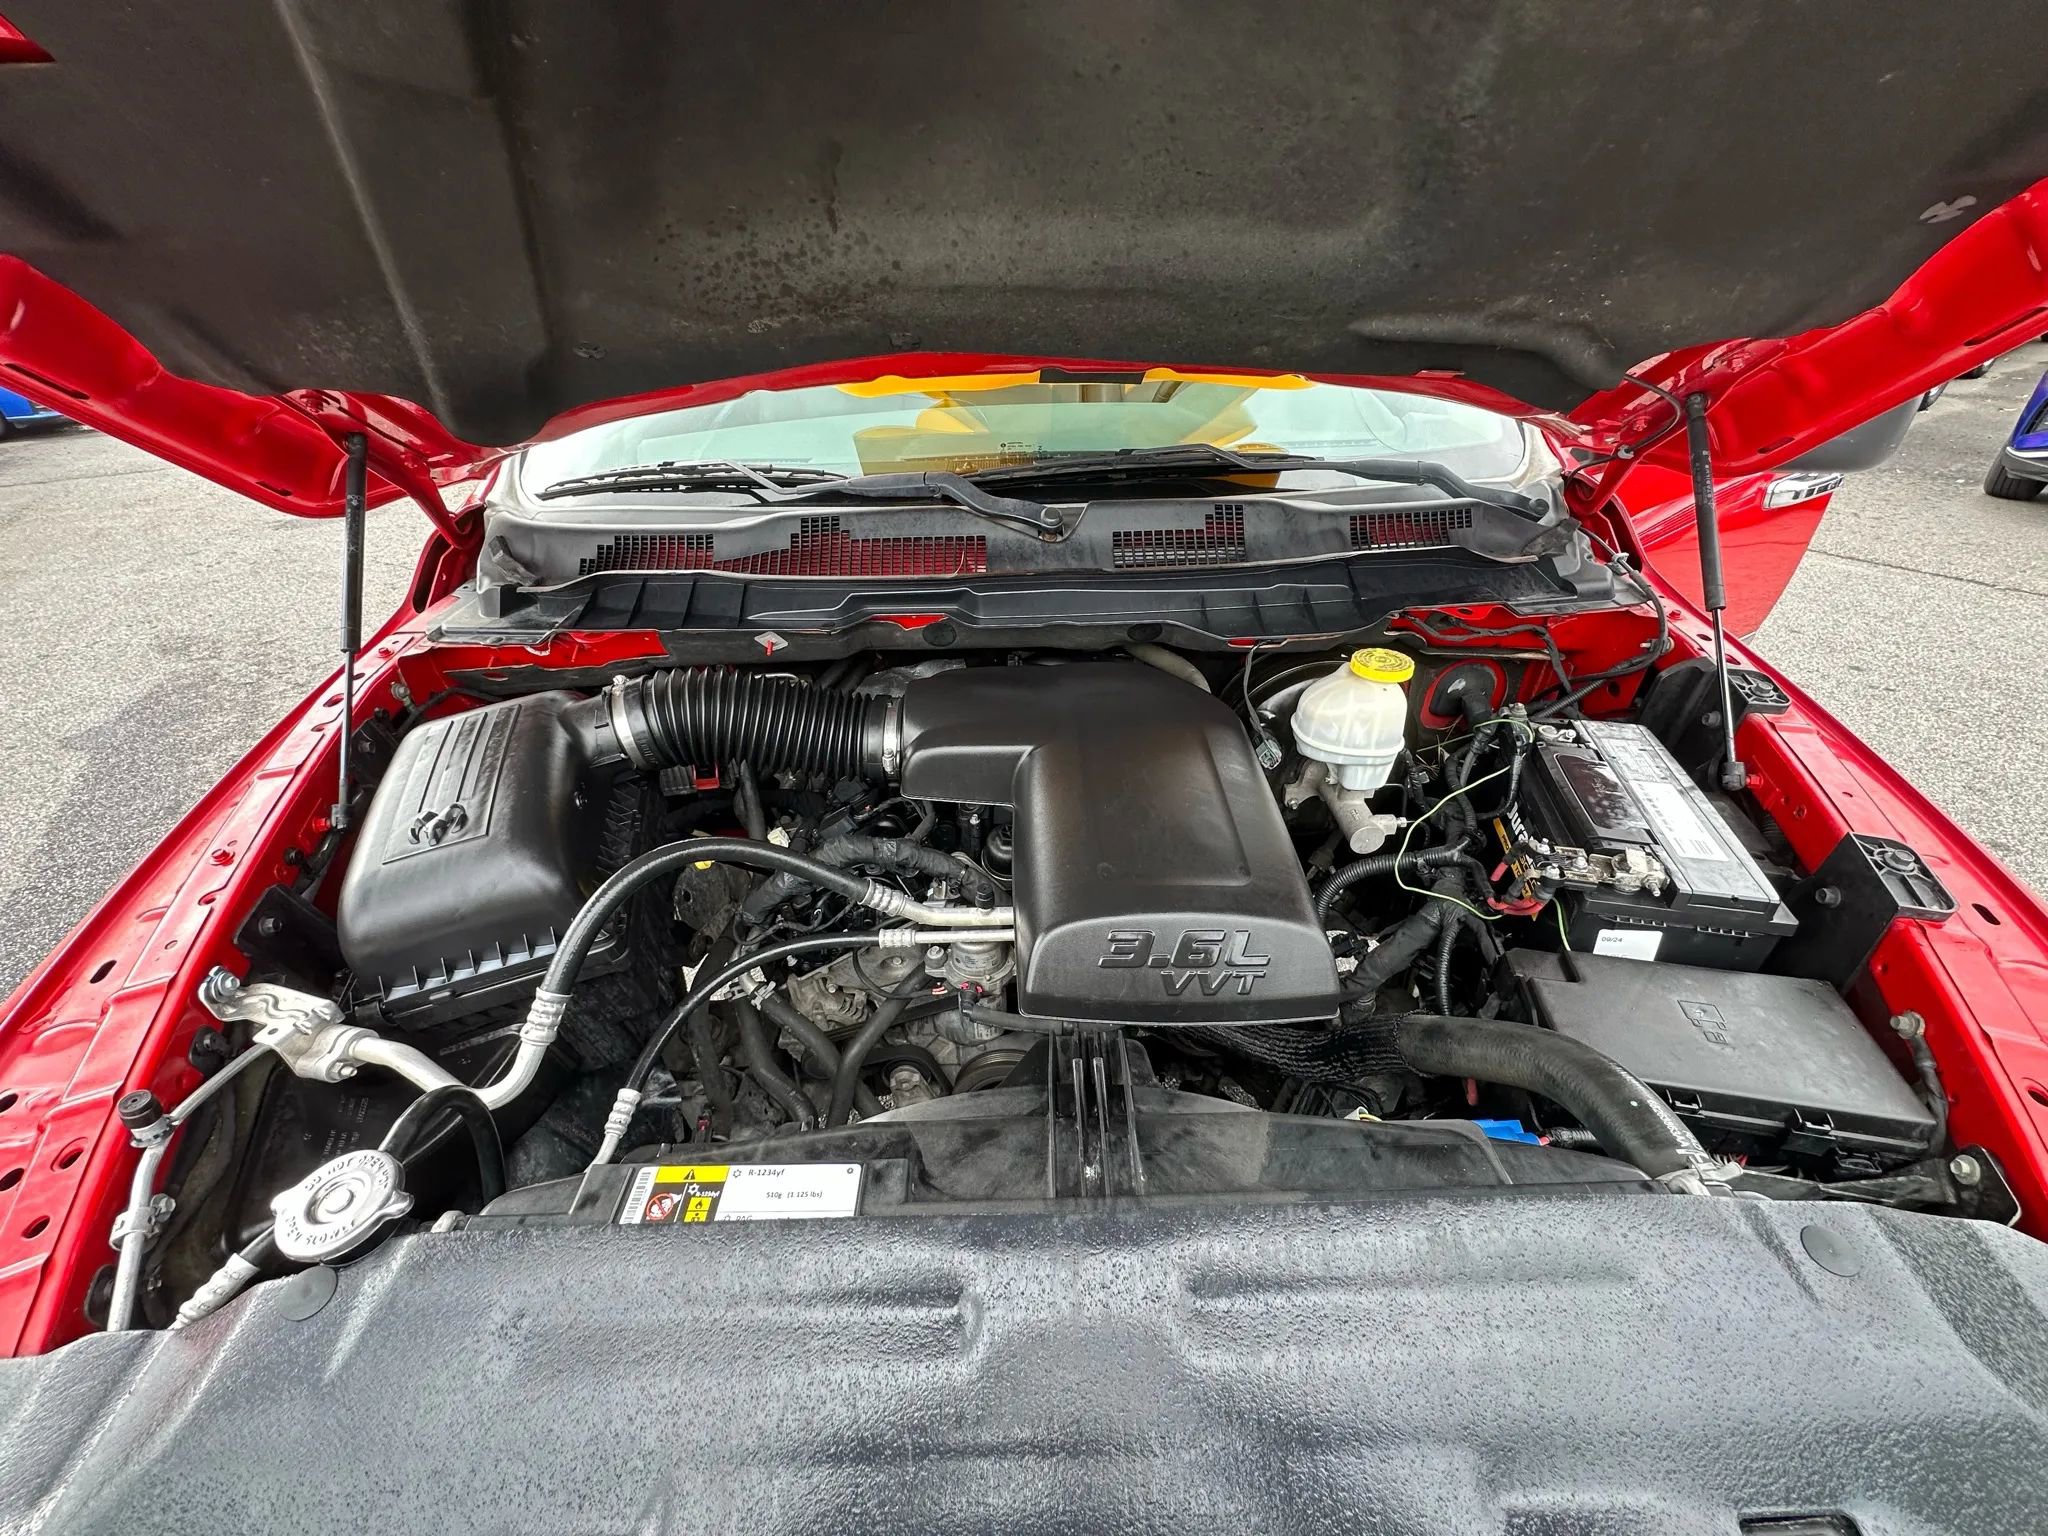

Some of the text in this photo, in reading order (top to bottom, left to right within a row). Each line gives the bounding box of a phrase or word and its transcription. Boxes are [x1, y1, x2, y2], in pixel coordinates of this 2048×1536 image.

[1097, 929, 1271, 968] 3.6L
[1160, 970, 1267, 996] VVT
[748, 1168, 785, 1177] R-1234yf
[765, 1191, 782, 1199] 510g
